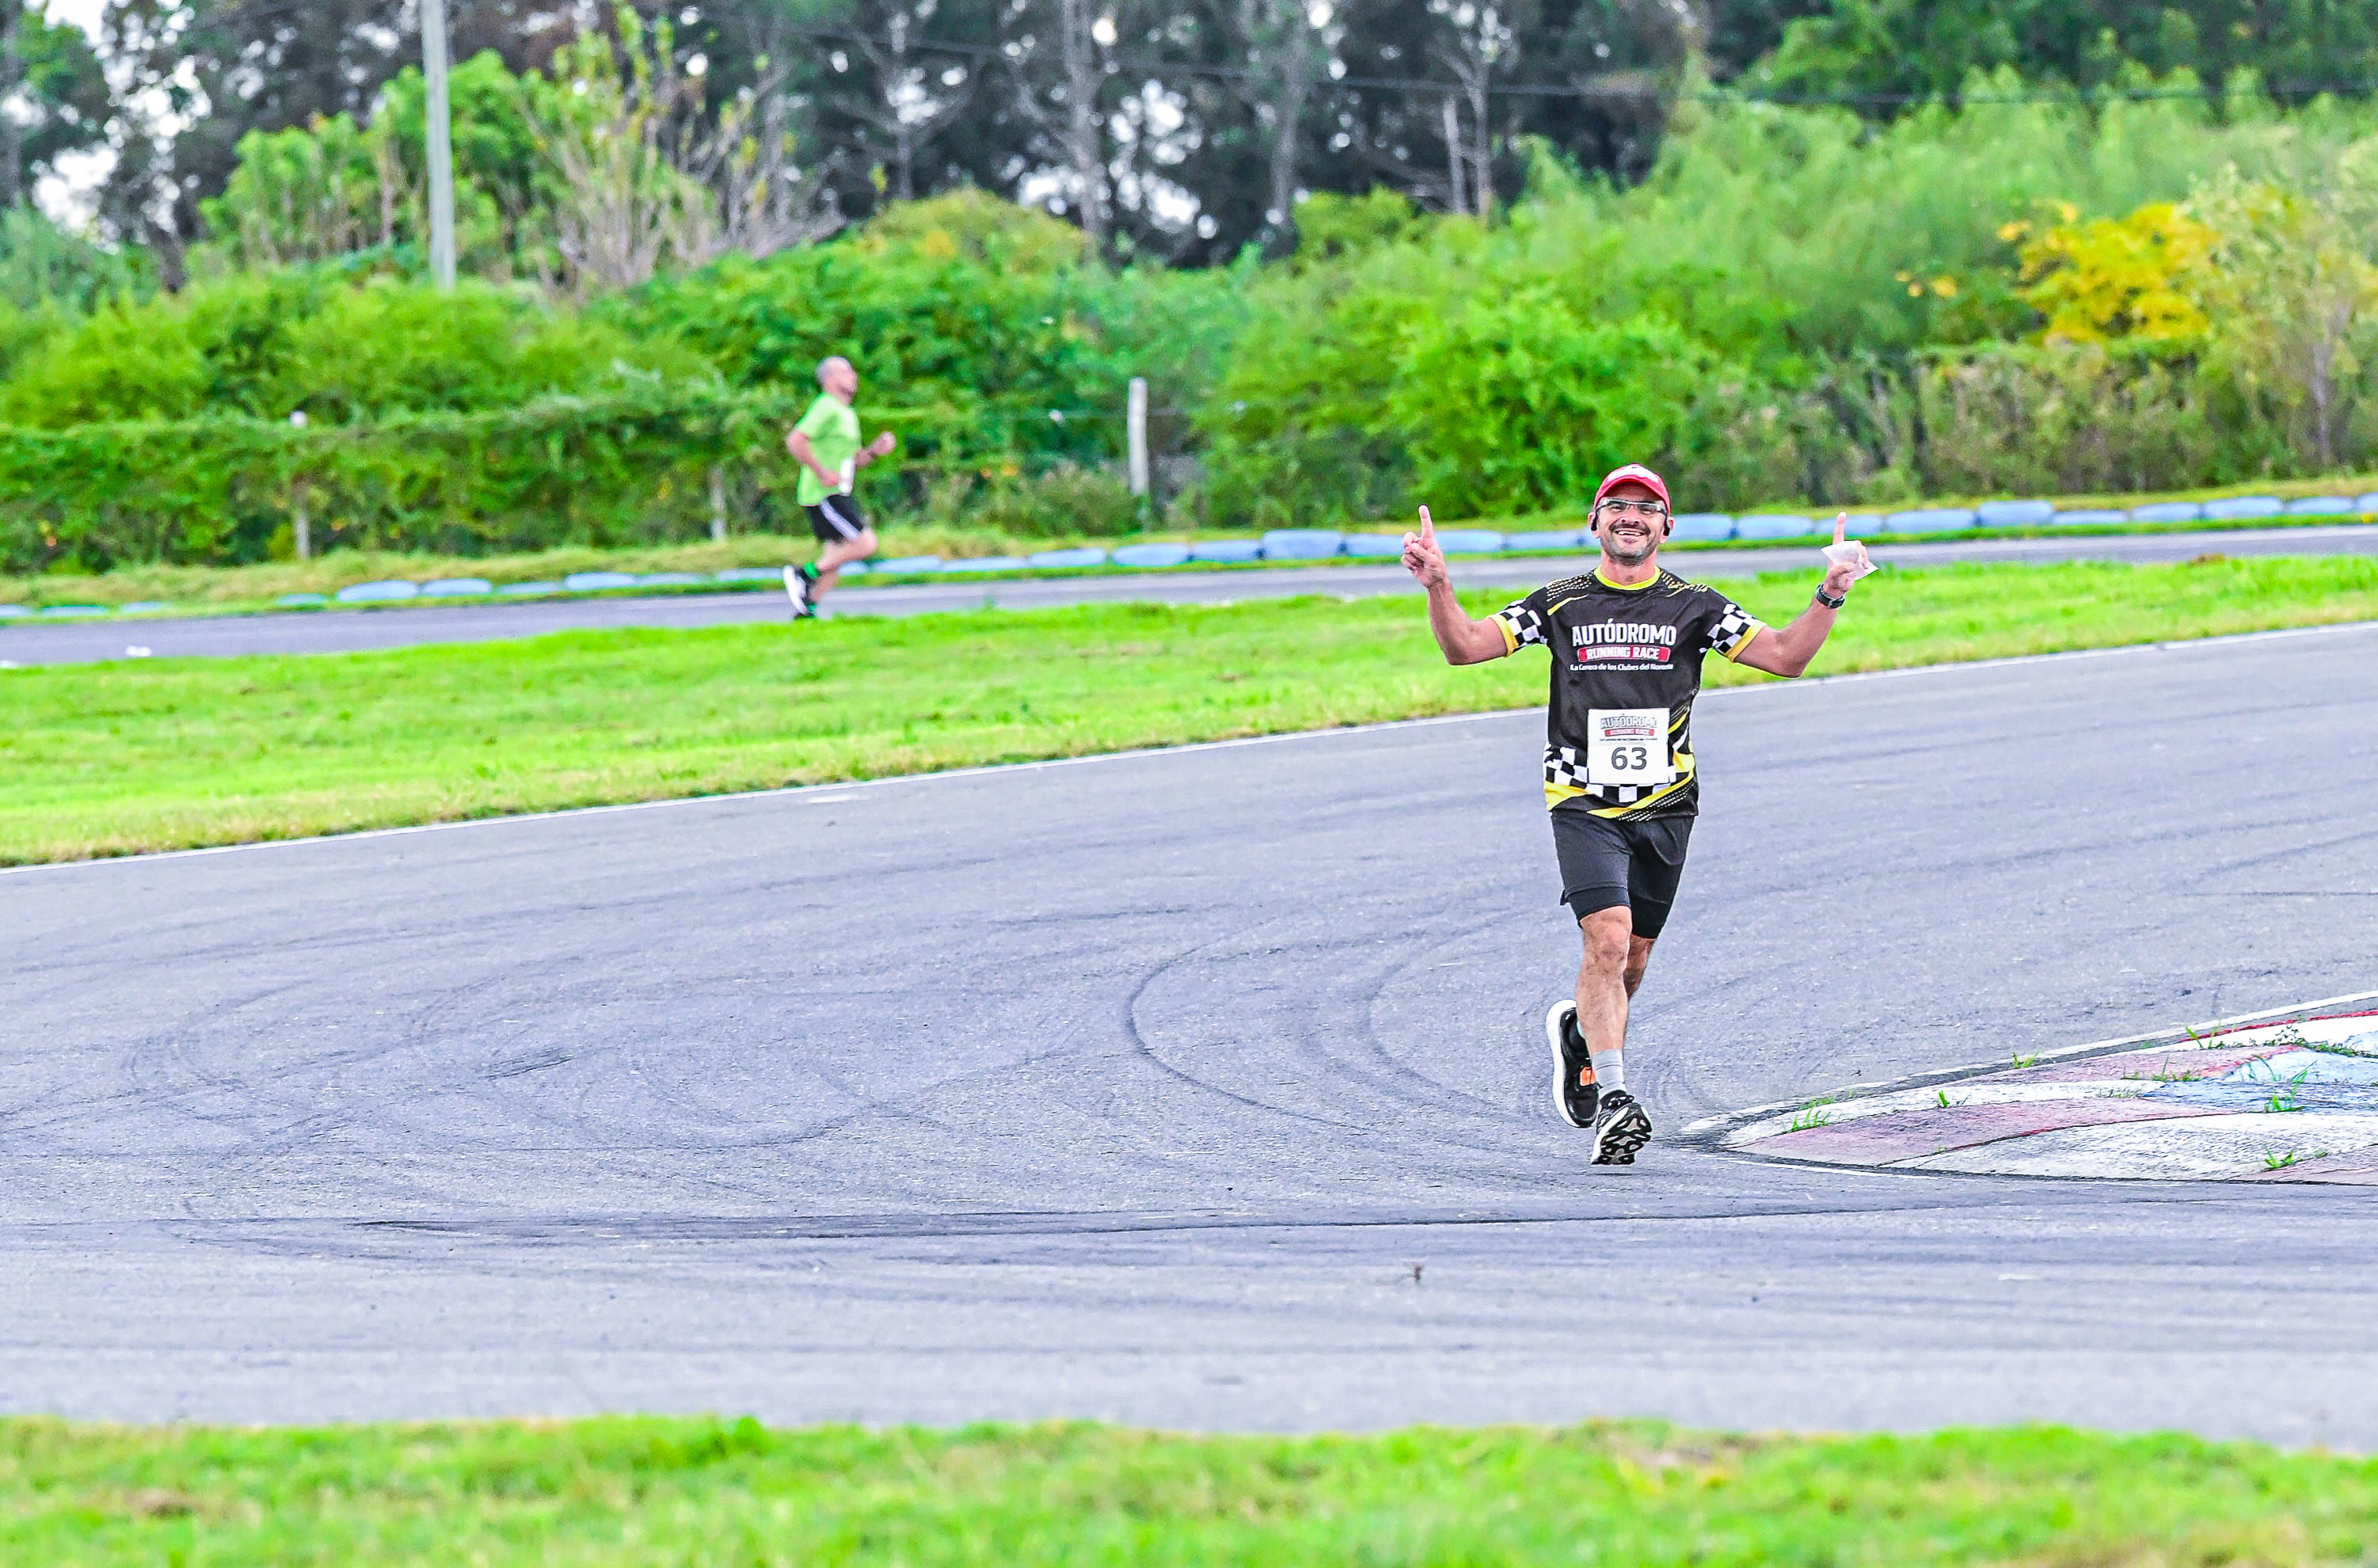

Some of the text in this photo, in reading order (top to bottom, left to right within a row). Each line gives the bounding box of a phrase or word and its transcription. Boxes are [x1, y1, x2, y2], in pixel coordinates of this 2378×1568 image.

[1572, 618, 1676, 646] AUTÓDROMO
[1586, 646, 1660, 660] RUNNING RACE
[1611, 747, 1647, 770] 63
